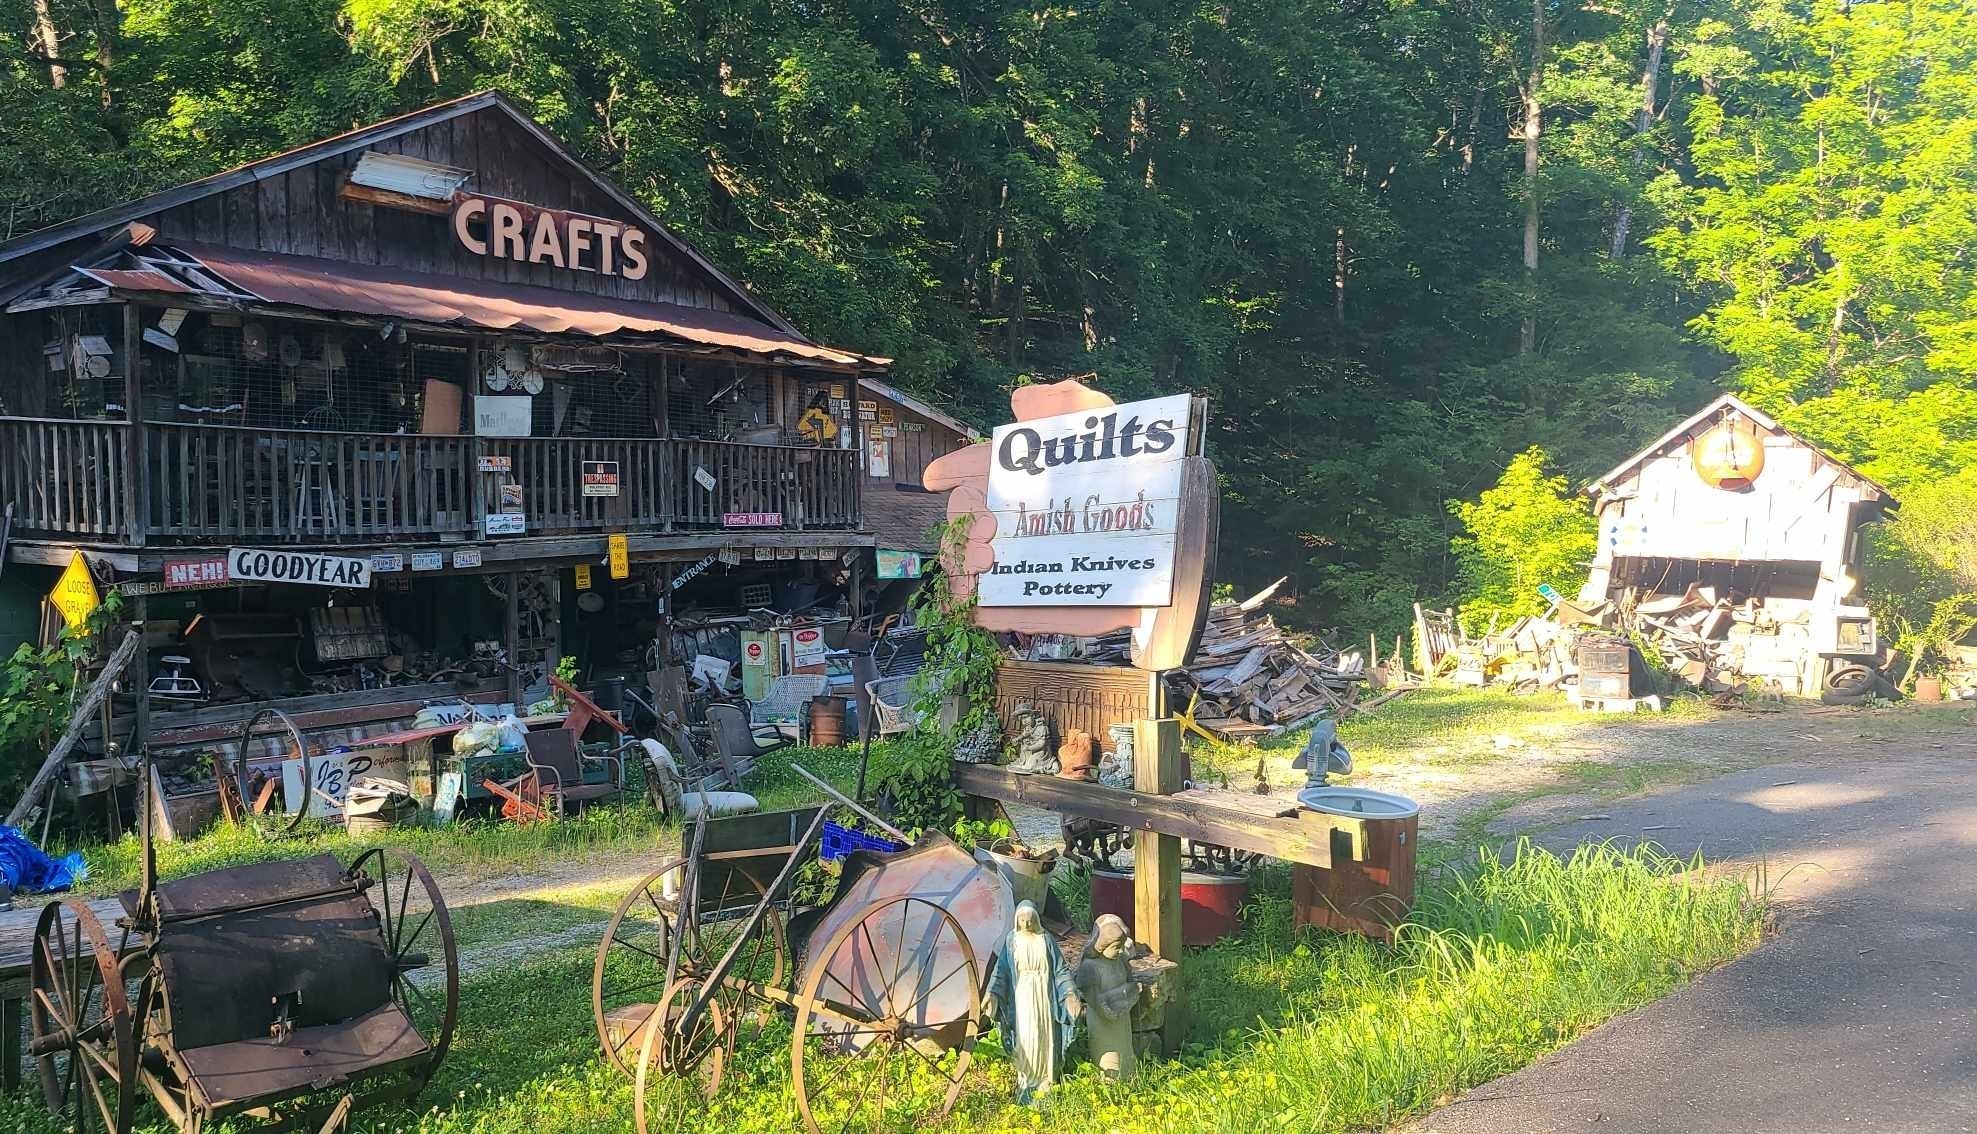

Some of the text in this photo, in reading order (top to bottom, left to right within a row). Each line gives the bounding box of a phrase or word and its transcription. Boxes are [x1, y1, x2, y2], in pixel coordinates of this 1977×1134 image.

[455, 199, 649, 281] CRAFTS
[998, 411, 1176, 476] Quilts
[748, 514, 763, 524] SOLD
[765, 514, 780, 524] HERE
[1015, 490, 1154, 537] Amish Goods
[237, 551, 364, 585] GOODYEAR
[673, 553, 716, 589] ENTRANCE
[991, 555, 1156, 576] Indian Knives
[67, 580, 90, 595] LOOSE
[1023, 580, 1113, 599] Pottery
